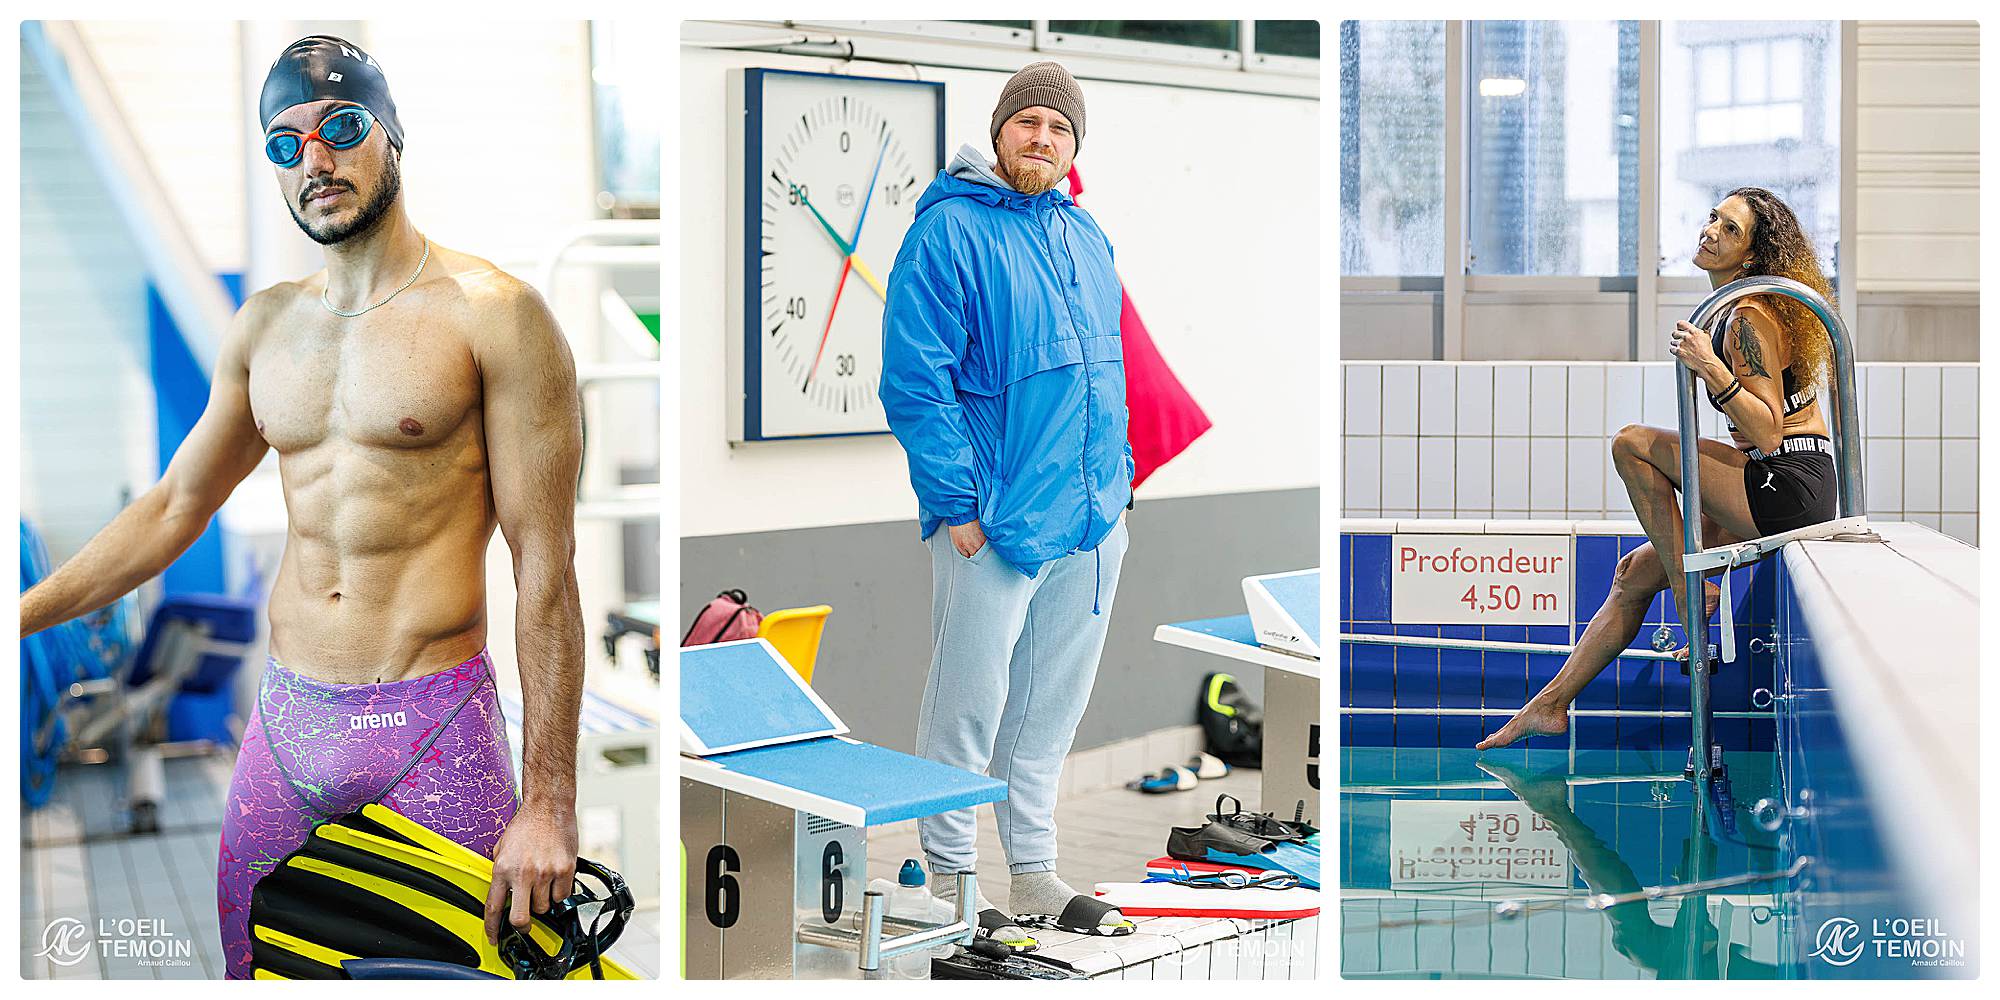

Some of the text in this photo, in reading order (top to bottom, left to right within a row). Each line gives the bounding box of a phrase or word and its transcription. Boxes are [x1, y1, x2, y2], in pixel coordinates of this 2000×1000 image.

[840, 131, 850, 153] 0
[885, 184, 901, 206] 10
[786, 296, 806, 319] 40
[836, 354, 855, 376] 30
[1400, 547, 1563, 574] Profondeur
[1460, 584, 1557, 614] 4,50 m
[350, 710, 408, 730] arena
[705, 845, 741, 929] 6
[822, 840, 844, 924] 6
